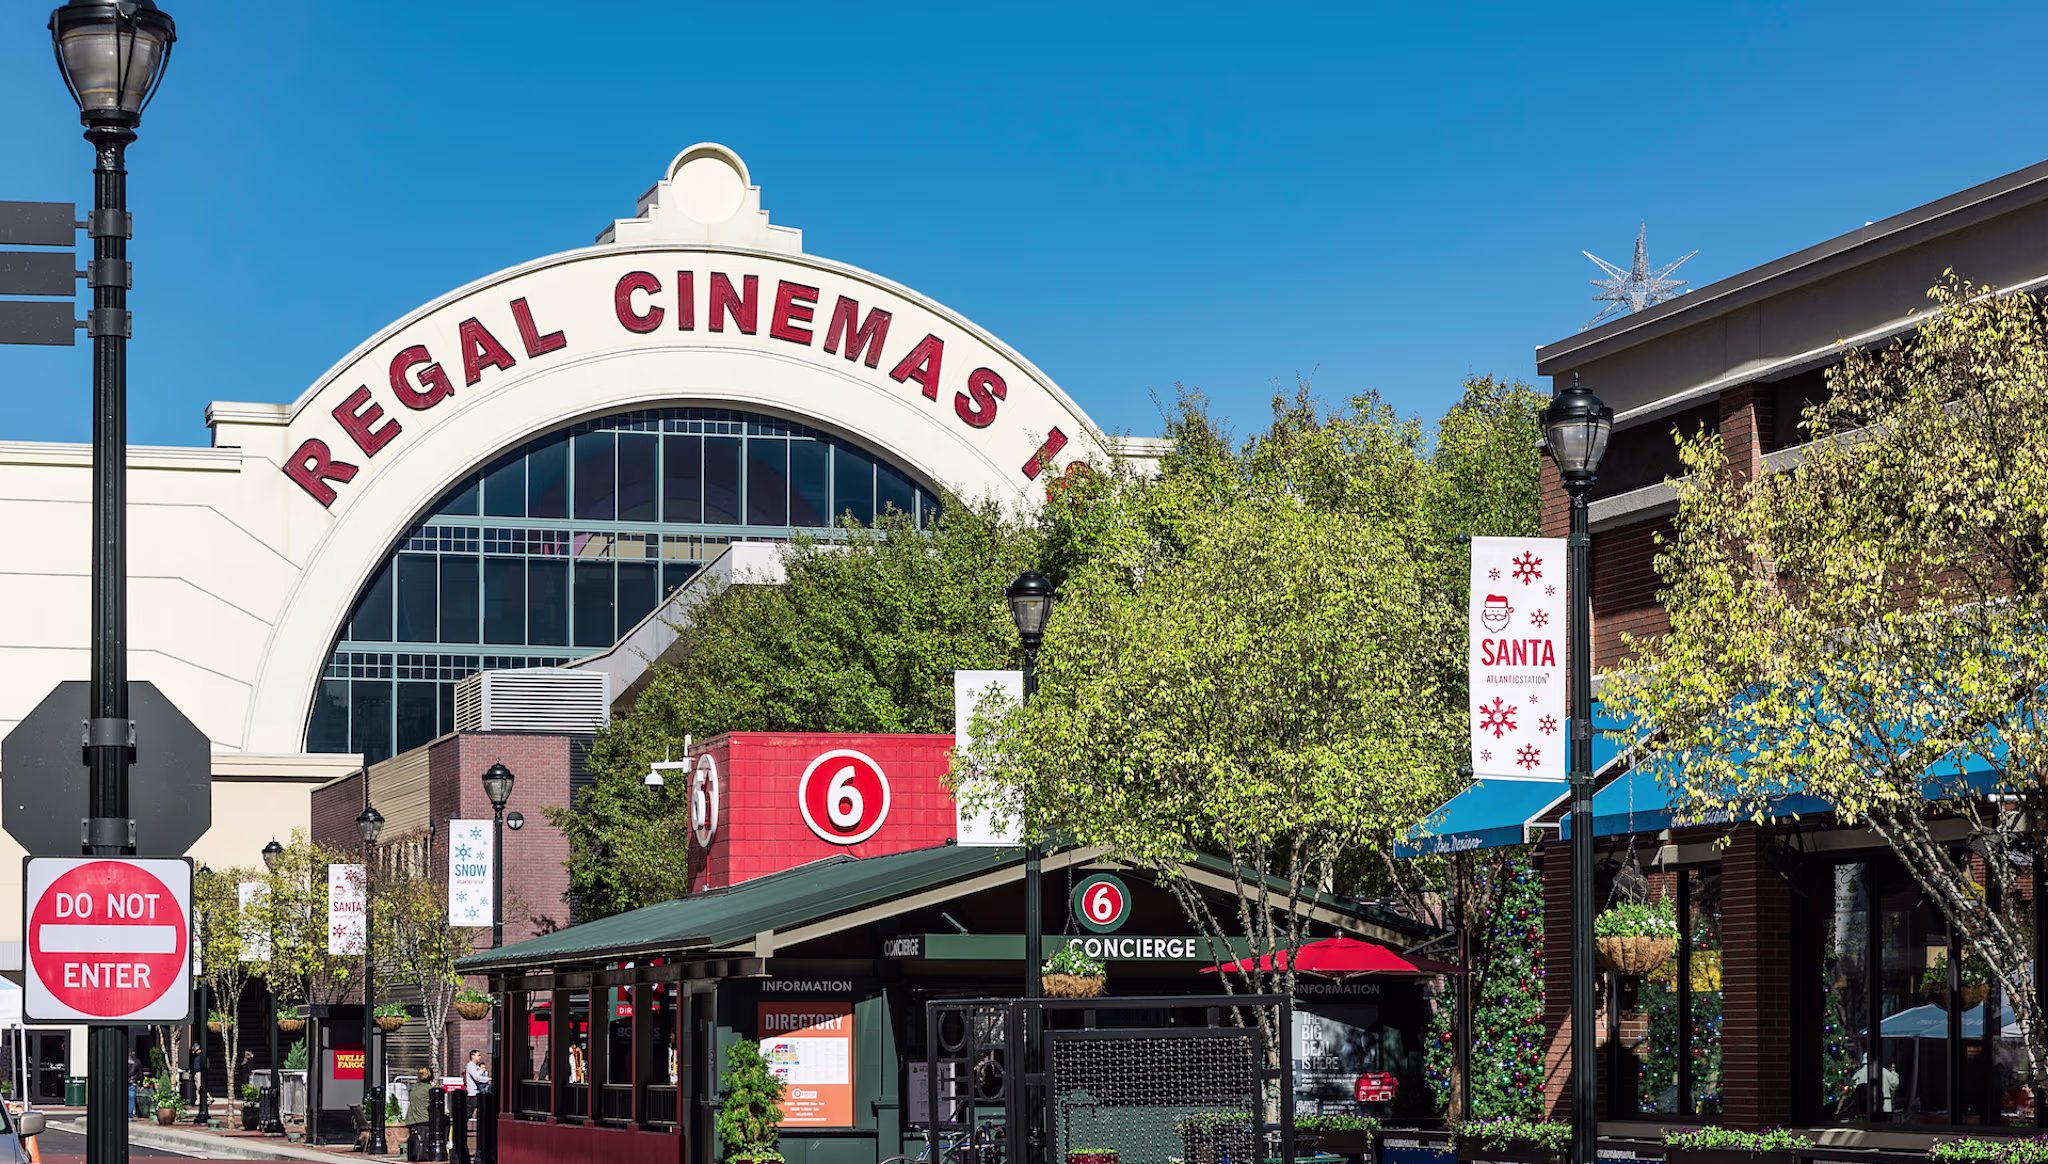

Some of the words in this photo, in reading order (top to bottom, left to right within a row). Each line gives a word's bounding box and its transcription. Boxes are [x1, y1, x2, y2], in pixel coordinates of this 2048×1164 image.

[282, 296, 567, 508] REGAL
[614, 269, 1008, 430] CINEMAS
[1481, 638, 1556, 667] SANTA
[827, 765, 864, 828] 6
[455, 864, 487, 876] SNOW
[56, 893, 93, 918] DO
[107, 893, 160, 919] NOT
[333, 902, 362, 912] SANTA
[1092, 887, 1114, 920] 6
[884, 937, 920, 957] CONCIERGE
[1070, 938, 1196, 958] CONCIERGE
[64, 962, 151, 988] ENTER
[762, 980, 852, 992] INFORMATION
[1296, 984, 1380, 994] INFORMATION
[765, 1013, 844, 1031] DIRECTORY
[1302, 1011, 1320, 1024] THE
[1302, 1025, 1322, 1040] BIG
[1302, 1041, 1333, 1056] DEAL
[337, 1054, 365, 1062] WELLS
[1302, 1057, 1311, 1070] IS
[1312, 1057, 1339, 1070] HERE
